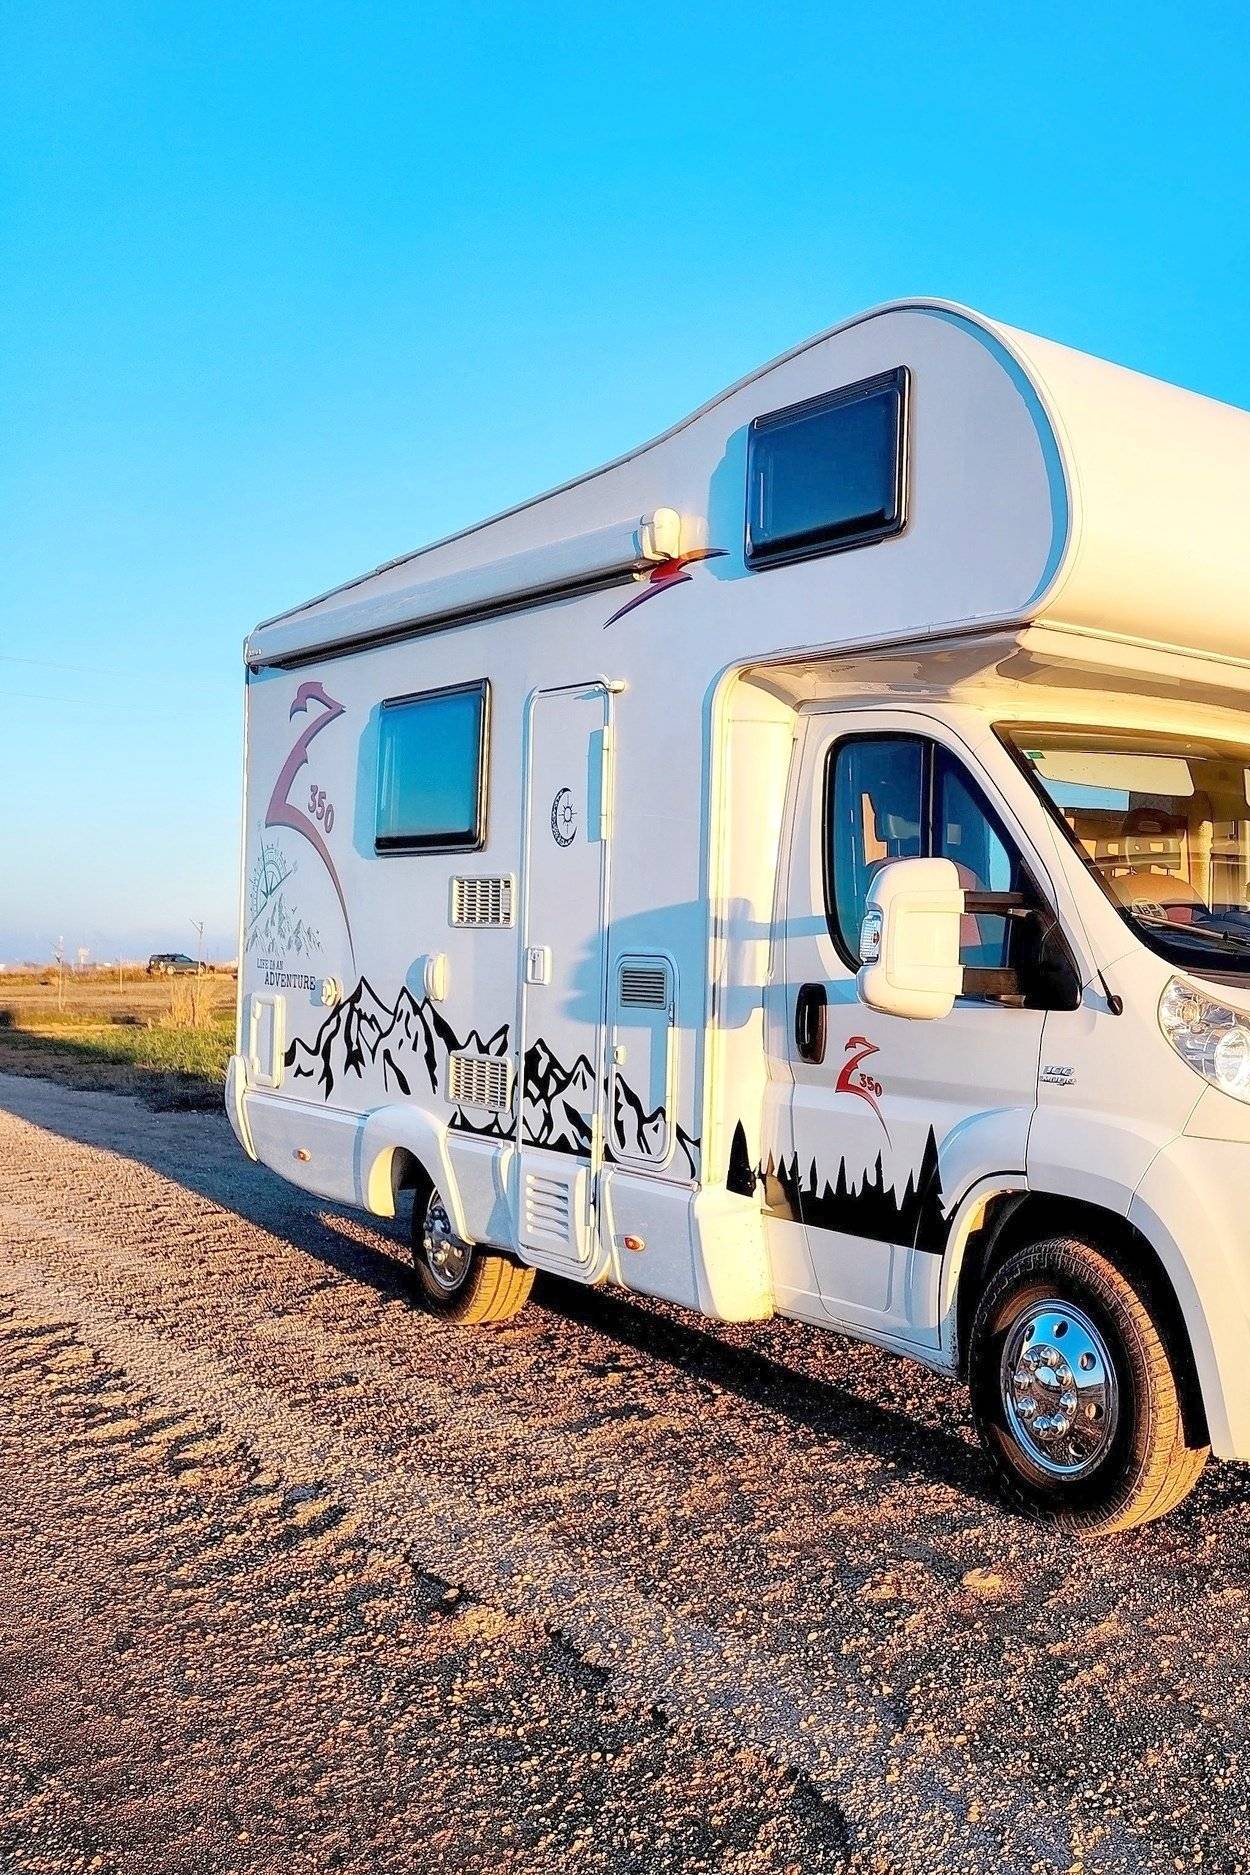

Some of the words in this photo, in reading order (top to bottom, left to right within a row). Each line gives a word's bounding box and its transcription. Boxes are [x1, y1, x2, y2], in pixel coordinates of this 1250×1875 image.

[308, 784, 335, 834] 350
[264, 971, 316, 991] ADVENTURE
[859, 1073, 883, 1098] 350
